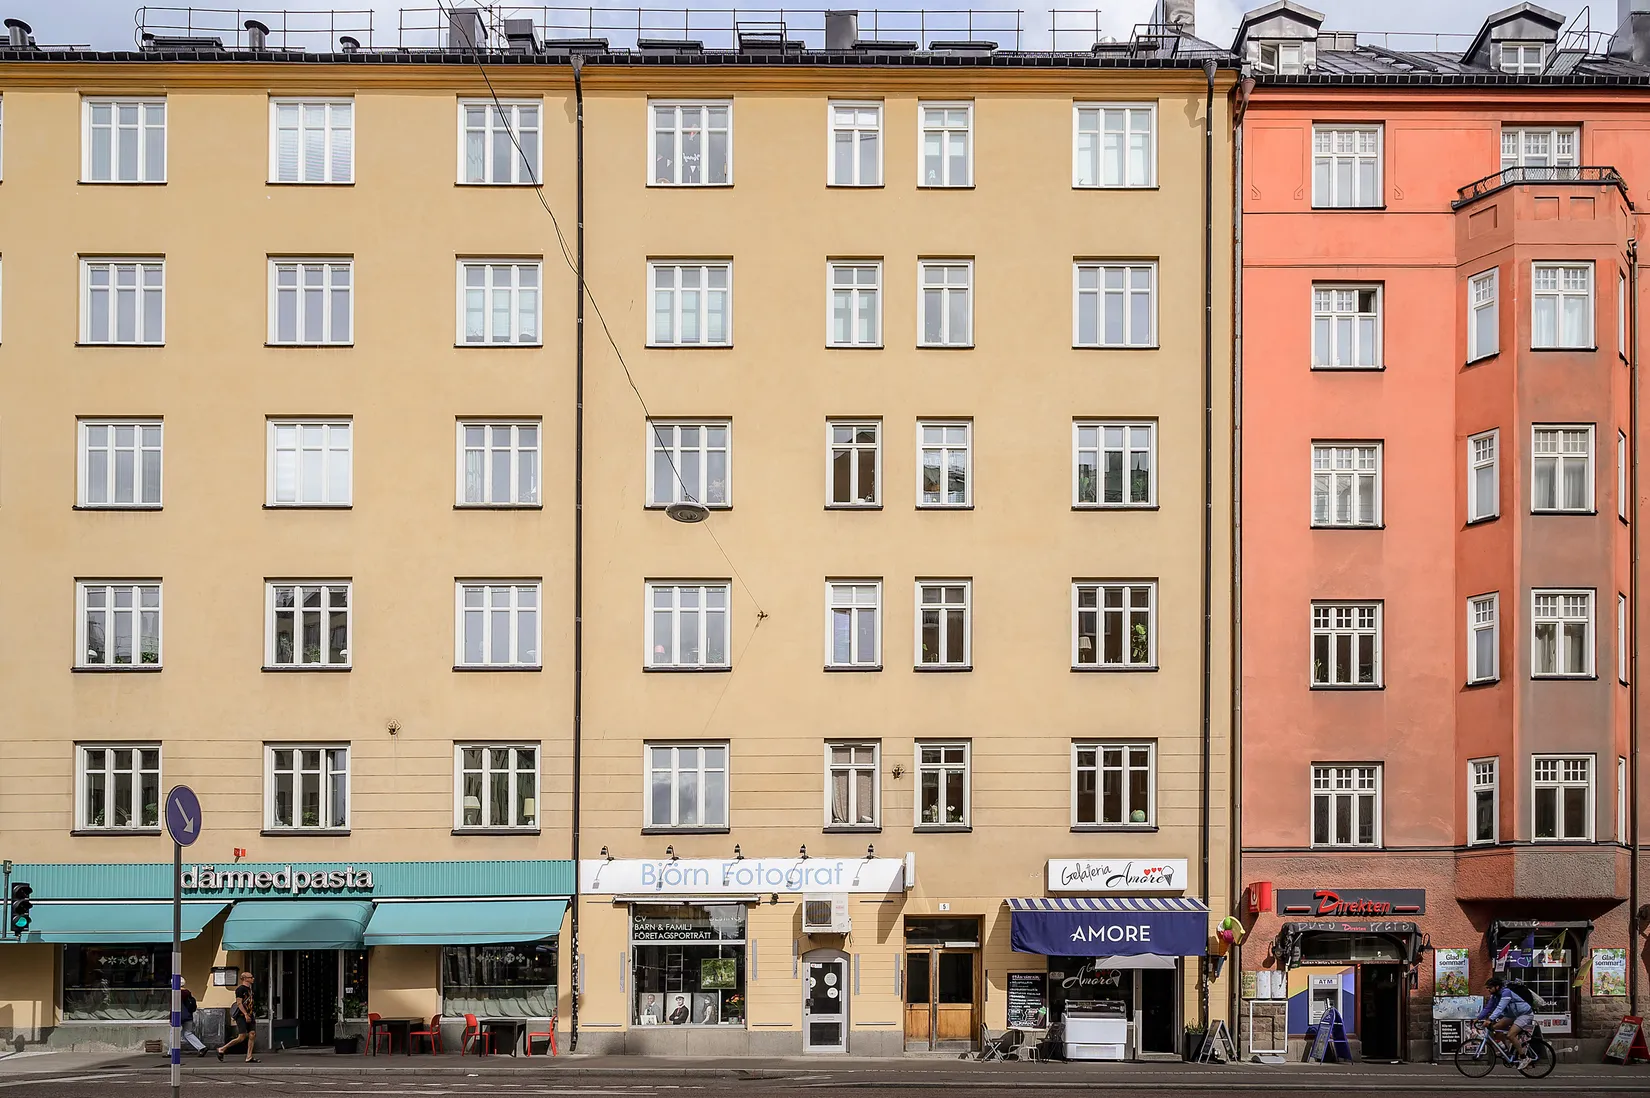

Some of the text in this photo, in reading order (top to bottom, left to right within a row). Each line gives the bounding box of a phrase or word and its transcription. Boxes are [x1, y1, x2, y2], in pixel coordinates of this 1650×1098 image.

[181, 865, 374, 894] därmedpasta
[642, 862, 844, 891] Björn Fotograf
[1061, 861, 1166, 888] Gelateria Amore
[1314, 890, 1390, 914] Direkten
[634, 915, 647, 923] CV
[634, 923, 692, 931] BARN & FAMILJ
[634, 931, 712, 940] FÖRETAGSPORTRÄTT
[1070, 925, 1151, 942] AMORE
[1061, 965, 1114, 989] Amore
